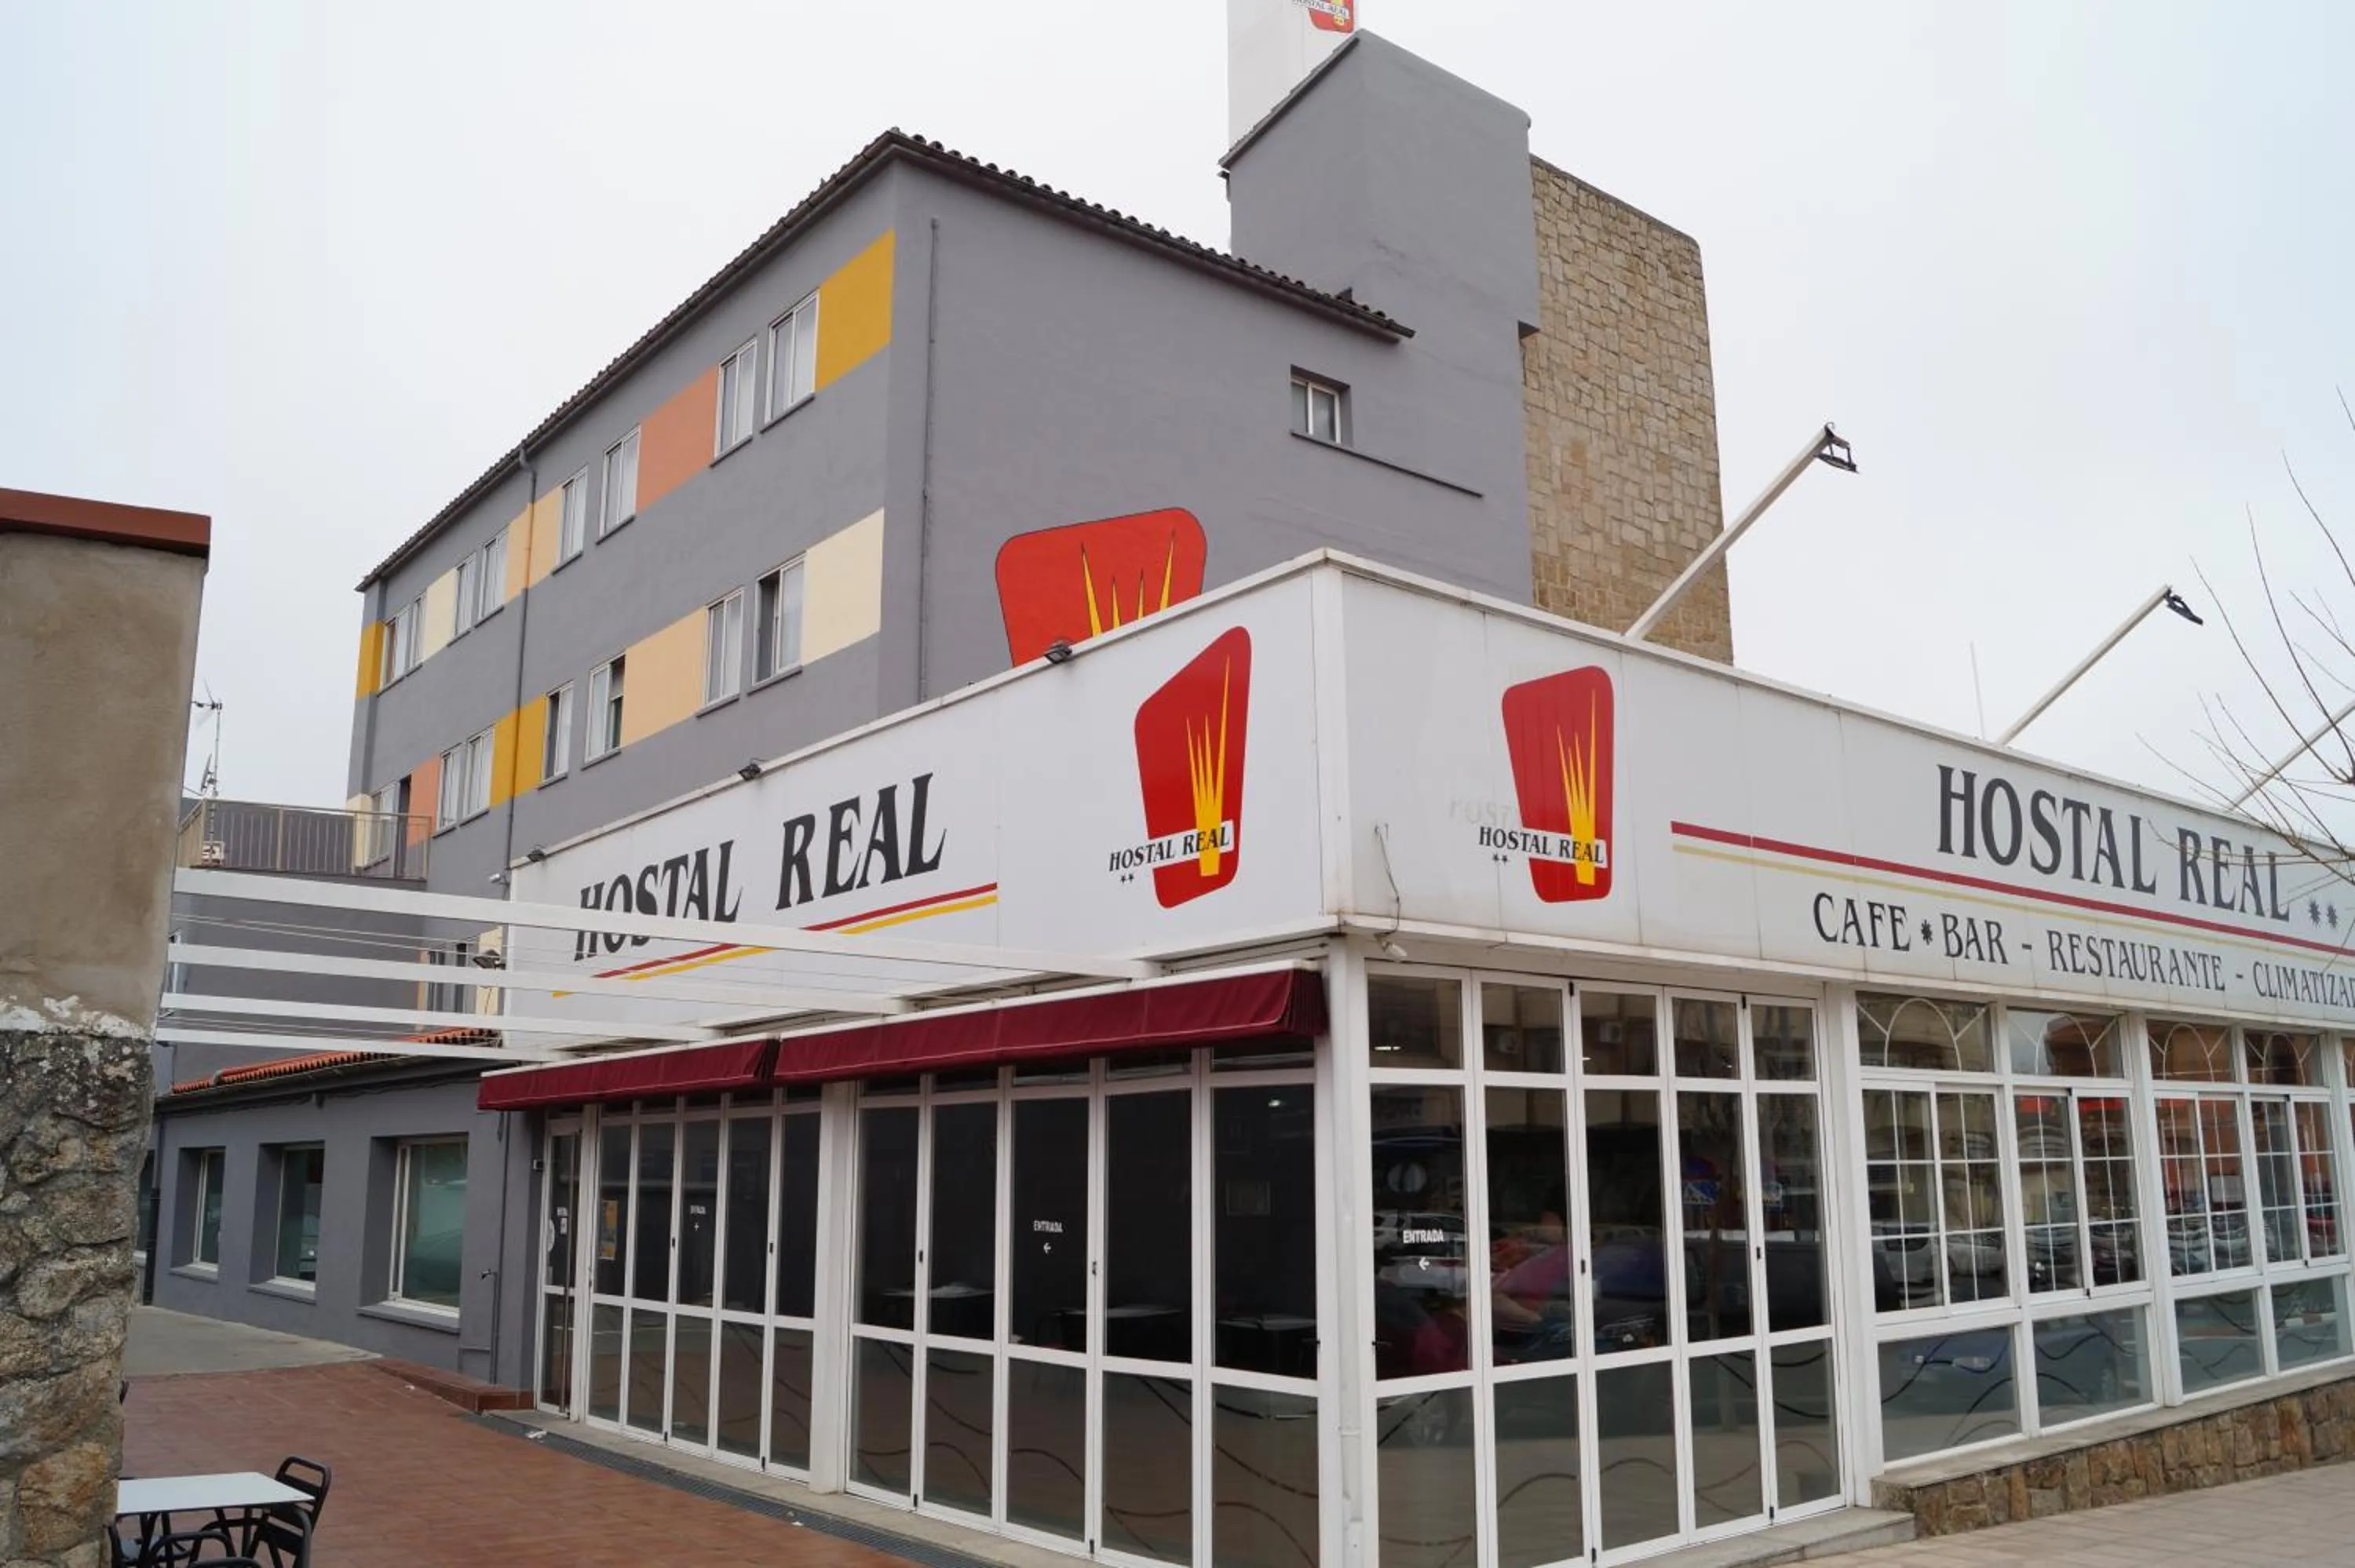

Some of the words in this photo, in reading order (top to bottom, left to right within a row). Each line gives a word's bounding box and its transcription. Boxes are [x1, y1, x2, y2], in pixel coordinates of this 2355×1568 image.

[574, 839, 743, 962] HOSTAL
[775, 772, 947, 910] REAL
[1108, 839, 1176, 872] HOSTAL
[1181, 826, 1230, 856] REAL
[1478, 826, 1552, 856] HOSTAL
[1558, 839, 1605, 863] REAL
[1937, 764, 2157, 895] HOSTAL
[2177, 826, 2290, 922] REAL
[1813, 892, 1911, 952] CAFE
[1940, 913, 2009, 965] BAR
[2046, 929, 2225, 992] RESTAURANTE
[1403, 1227, 1444, 1244] ENTRADA
